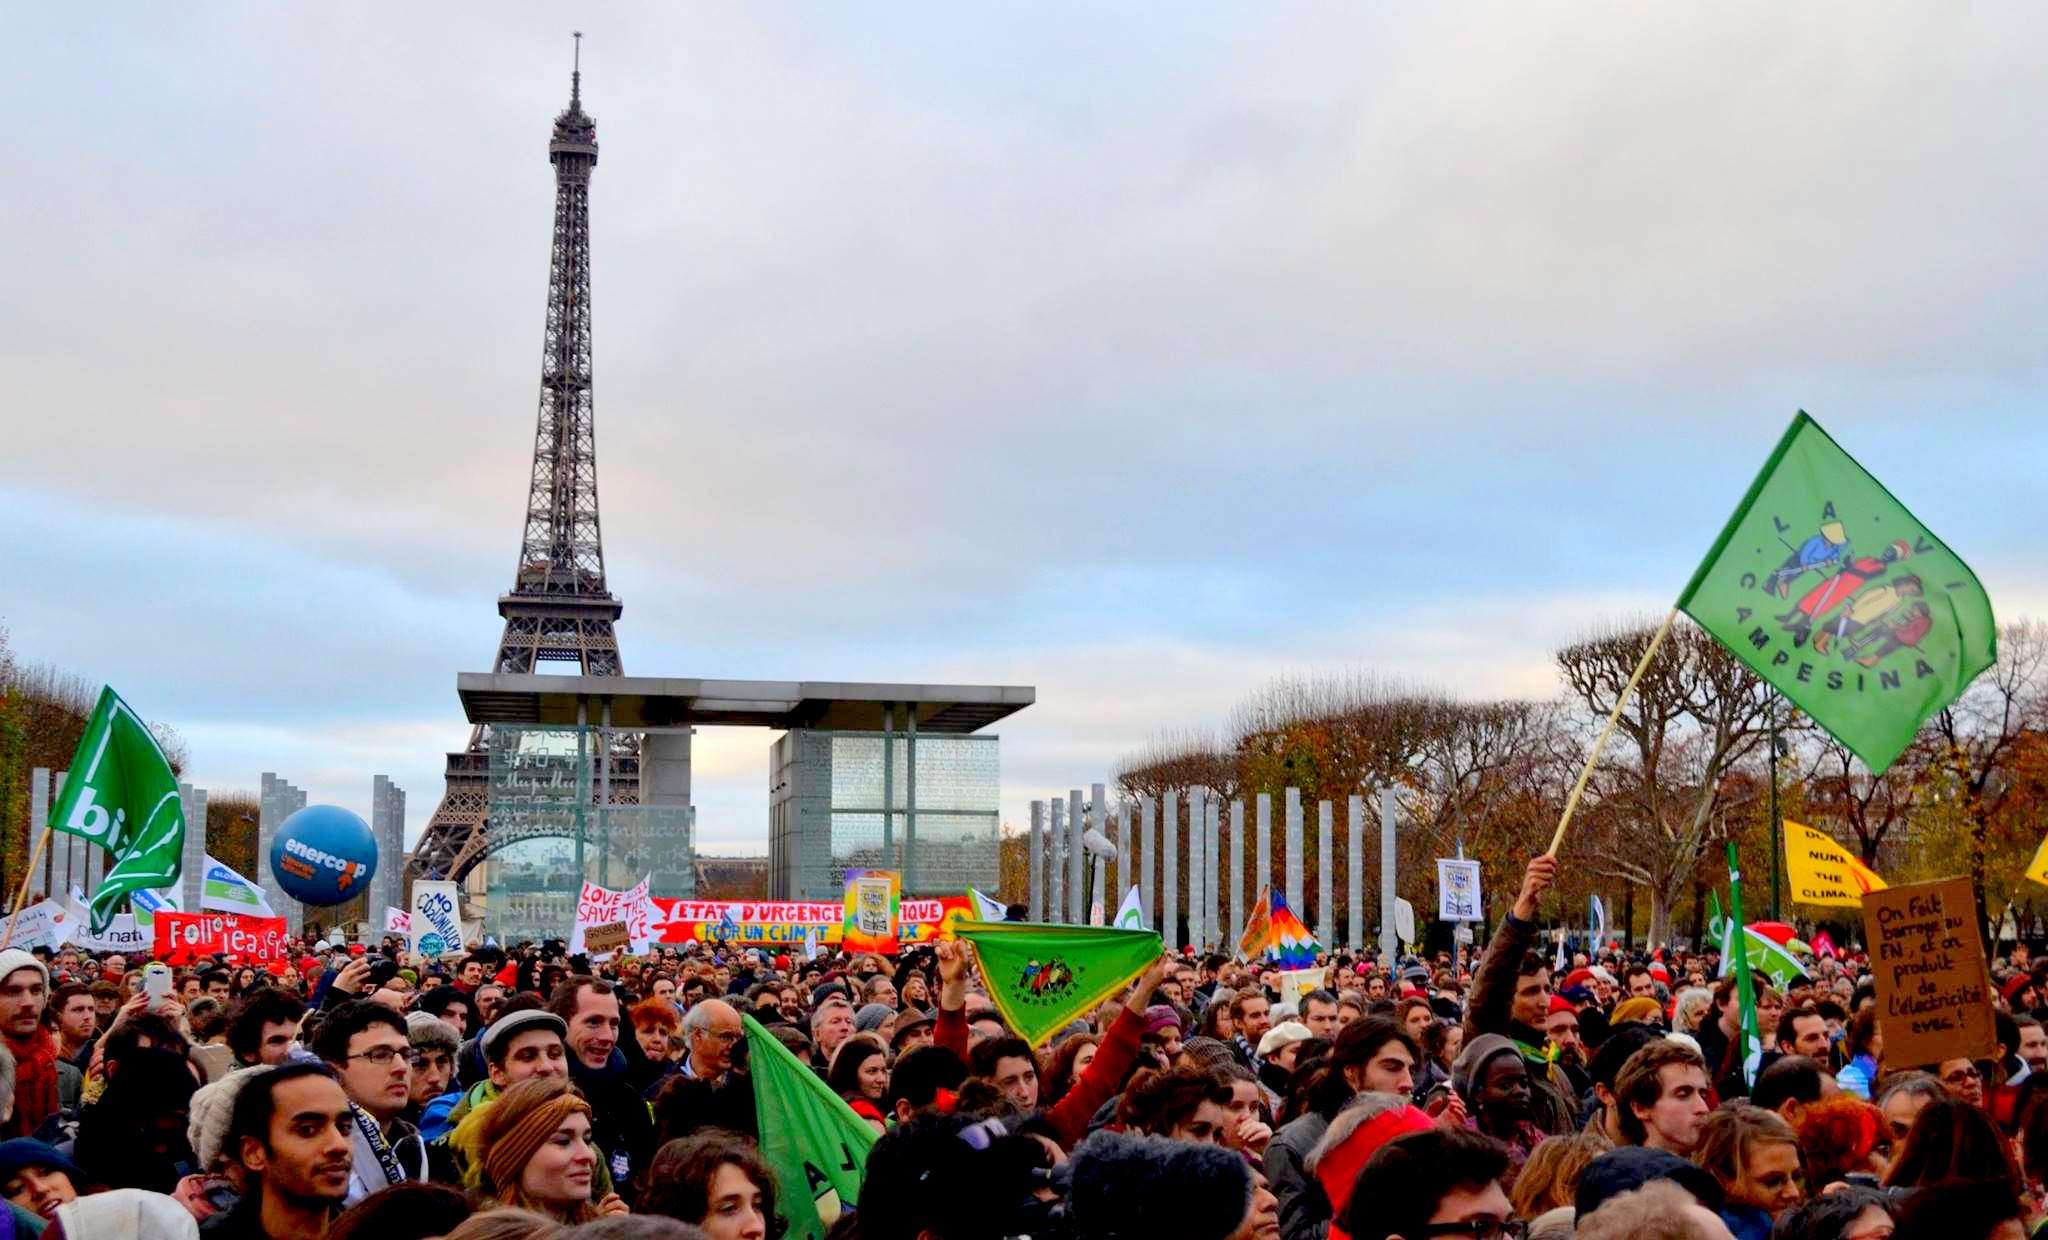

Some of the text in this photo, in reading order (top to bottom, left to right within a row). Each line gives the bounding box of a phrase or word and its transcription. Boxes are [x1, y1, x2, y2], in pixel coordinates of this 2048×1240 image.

[1773, 501, 1967, 591] LA VI
[1736, 571, 1935, 692] CAMPESINA
[285, 838, 366, 878] enercoop
[1815, 872, 1841, 883] THE
[434, 892, 452, 913] NO
[582, 884, 622, 905] LOVE
[1802, 889, 1858, 900] CLIMA
[578, 902, 617, 922] SAVE
[678, 903, 729, 921] ETAT
[743, 904, 844, 922] D'URGENCE
[1877, 906, 1904, 923] On
[744, 926, 762, 940] UN
[1880, 916, 1963, 940] barrage au
[1920, 936, 1936, 953] et
[1941, 937, 1963, 948] on
[1894, 954, 1954, 988] produit
[1918, 977, 1937, 995] de
